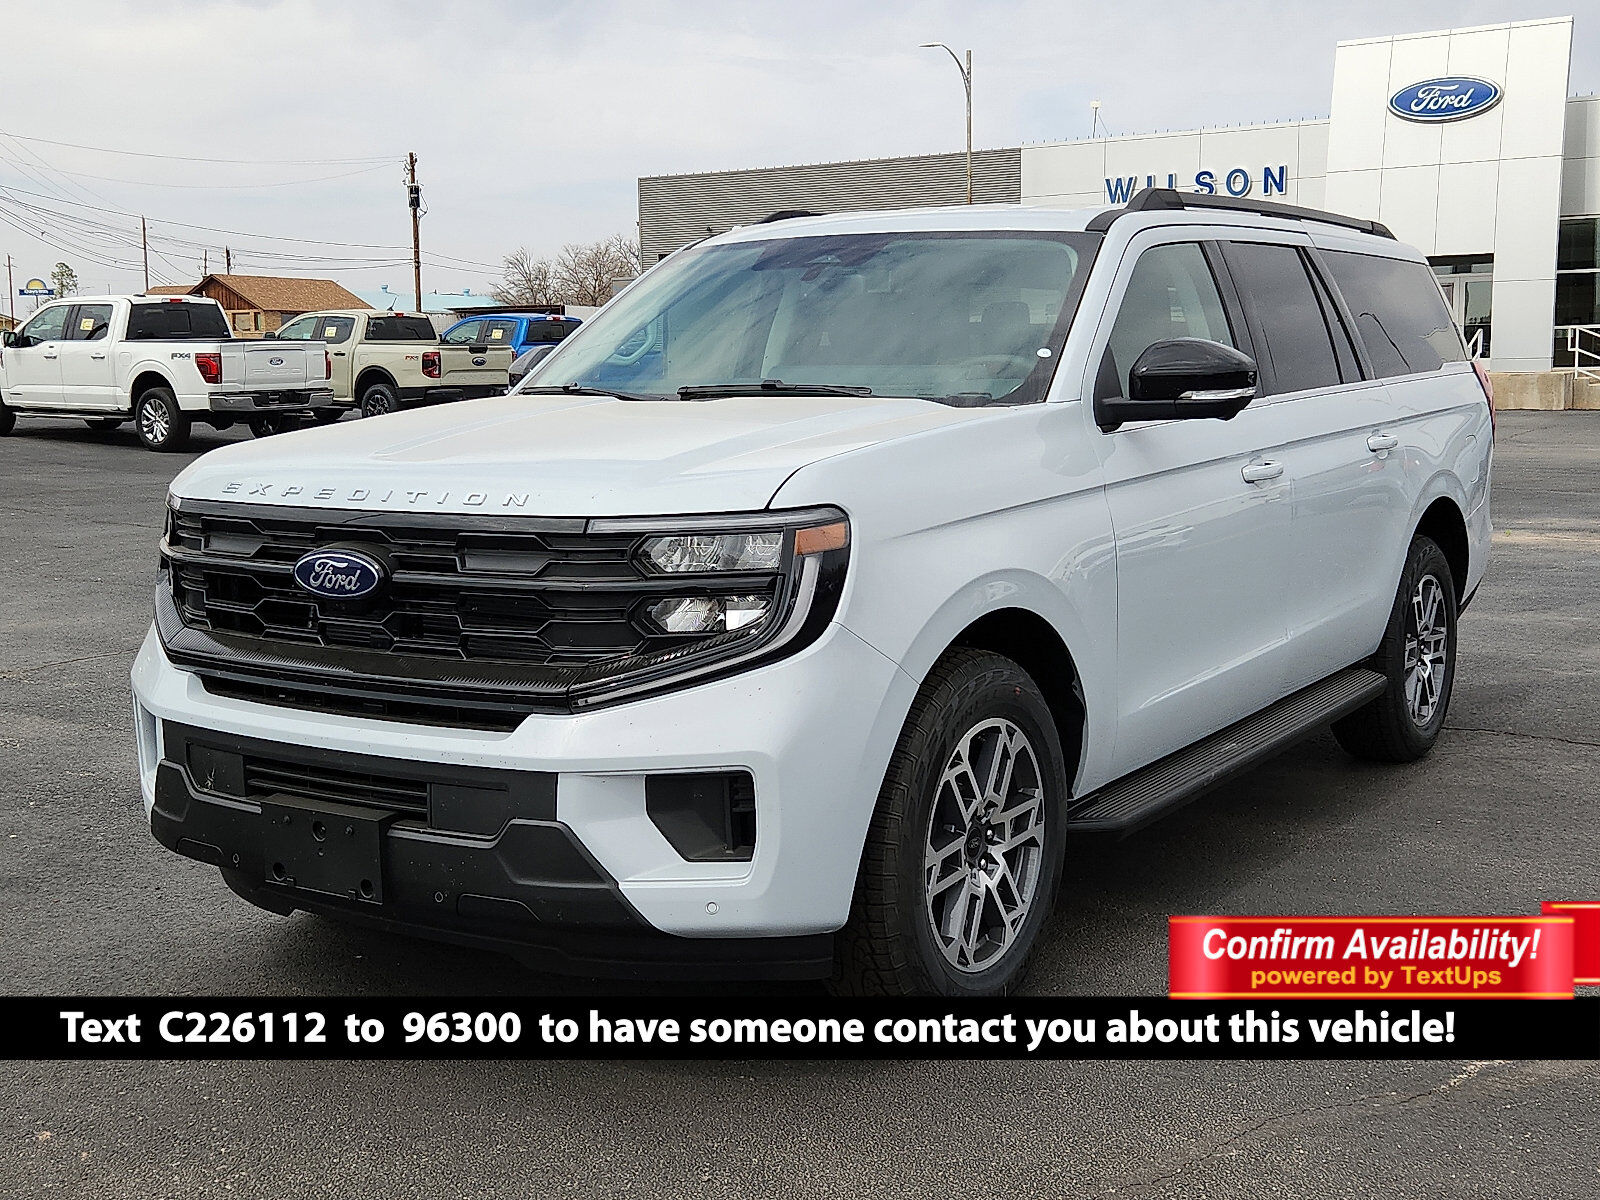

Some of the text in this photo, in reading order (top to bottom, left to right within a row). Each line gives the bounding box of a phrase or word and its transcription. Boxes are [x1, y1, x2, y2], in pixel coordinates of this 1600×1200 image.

[1410, 84, 1475, 112] Ford
[171, 352, 191, 360] FX4
[221, 482, 530, 508] EXPEDITION
[309, 558, 362, 591] Ford
